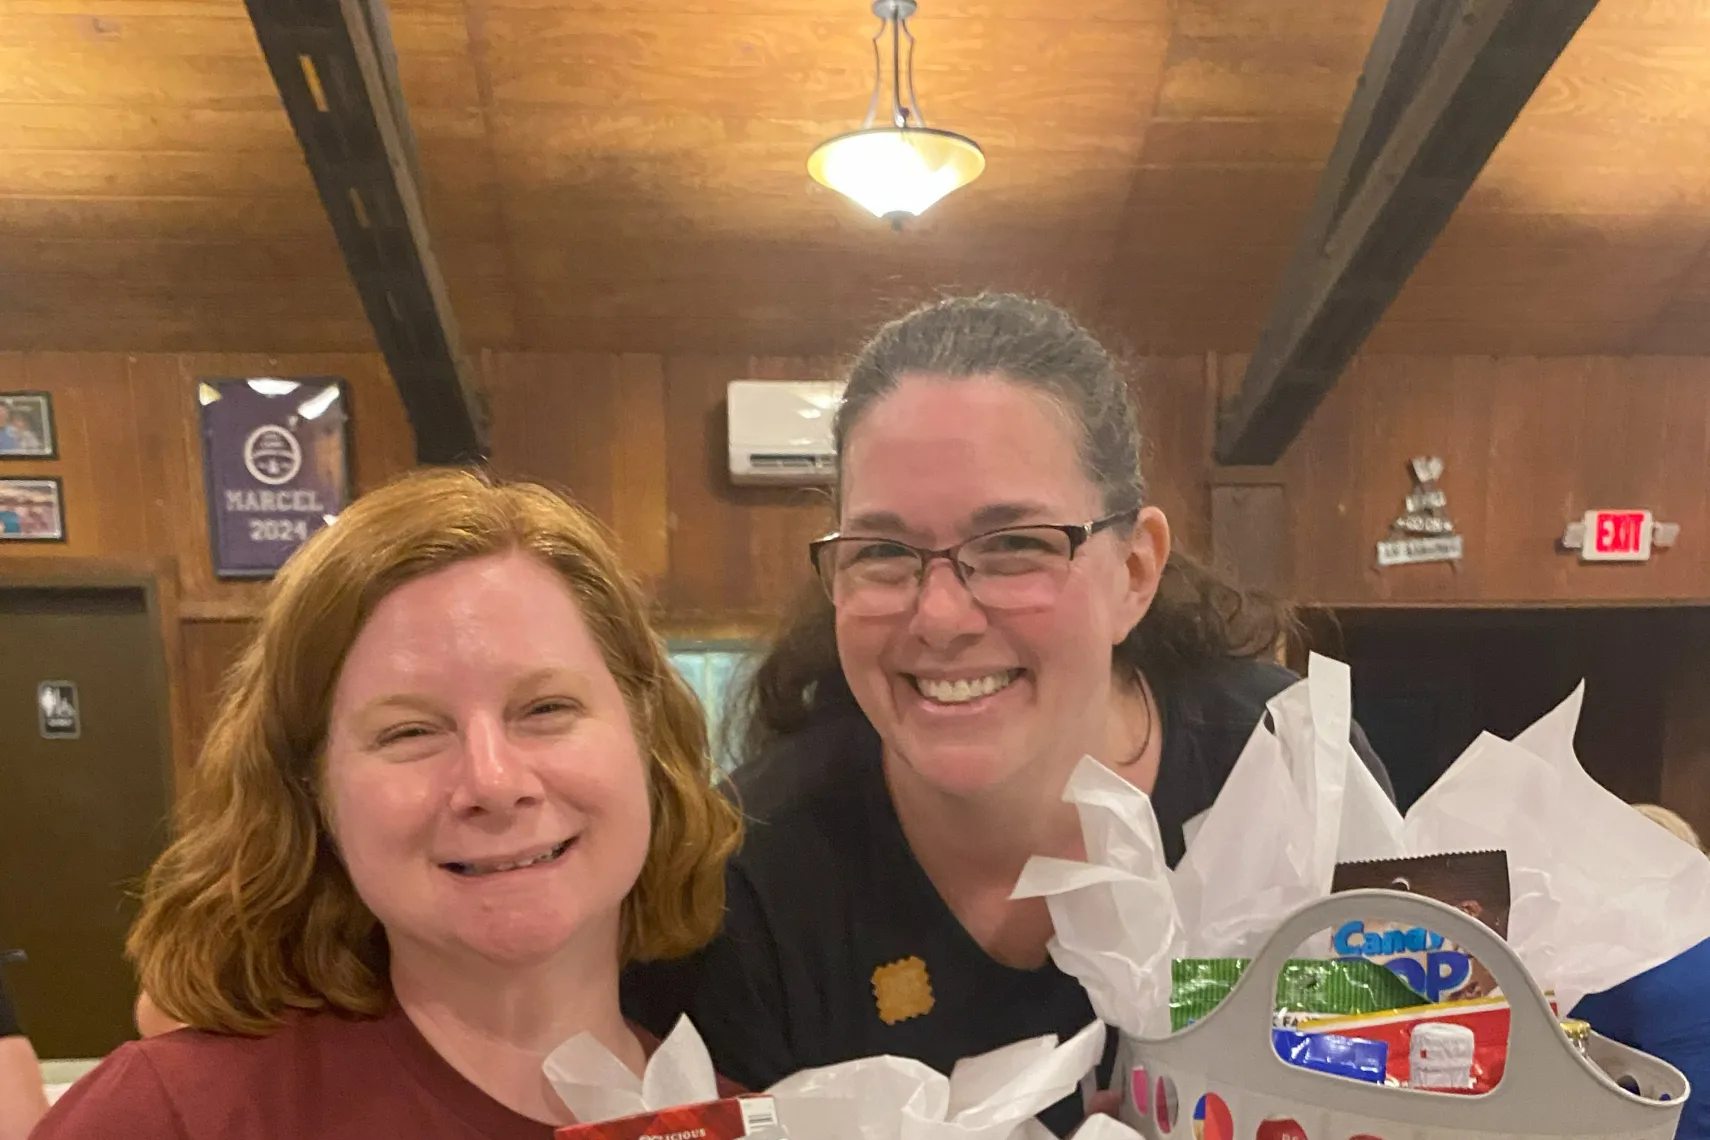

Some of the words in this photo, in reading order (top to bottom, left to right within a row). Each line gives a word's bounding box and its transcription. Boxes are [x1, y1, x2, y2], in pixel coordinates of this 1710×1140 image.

[225, 489, 324, 512] MARCEL
[250, 518, 308, 541] 2024
[1597, 513, 1645, 553] EXIT
